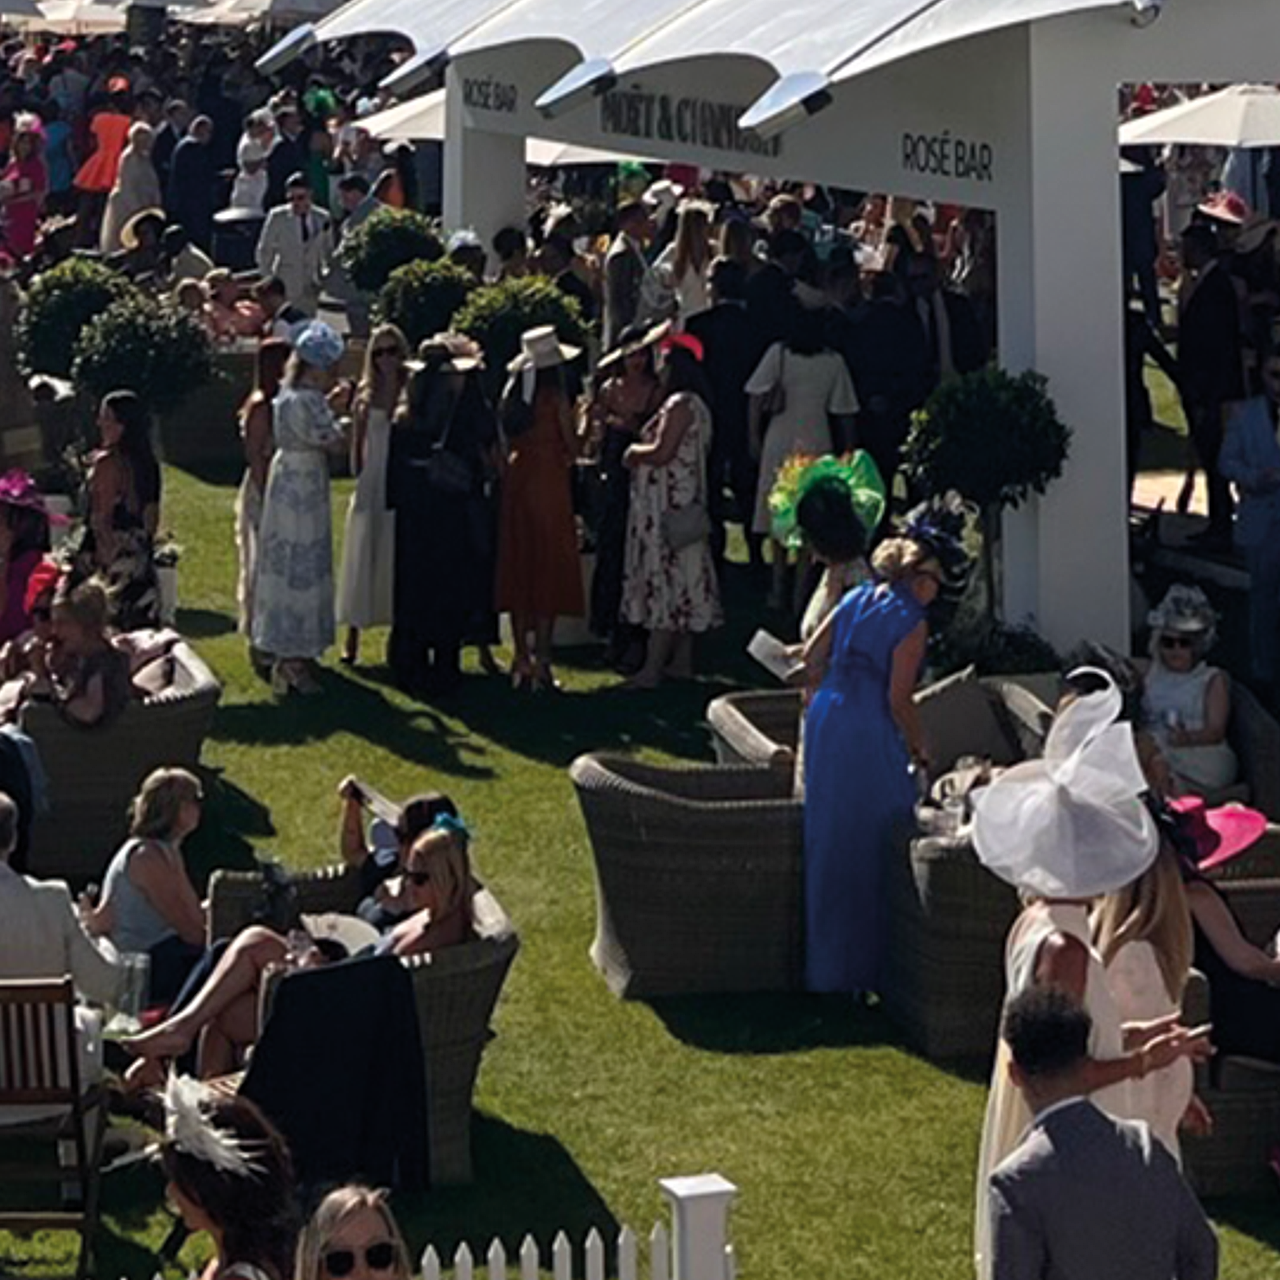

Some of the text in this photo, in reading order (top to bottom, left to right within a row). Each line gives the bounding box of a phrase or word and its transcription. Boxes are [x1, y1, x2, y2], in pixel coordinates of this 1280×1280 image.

[463, 74, 517, 112] ROSÉ BAR
[657, 94, 674, 141] &
[902, 128, 993, 182] ROSÉ BAR
